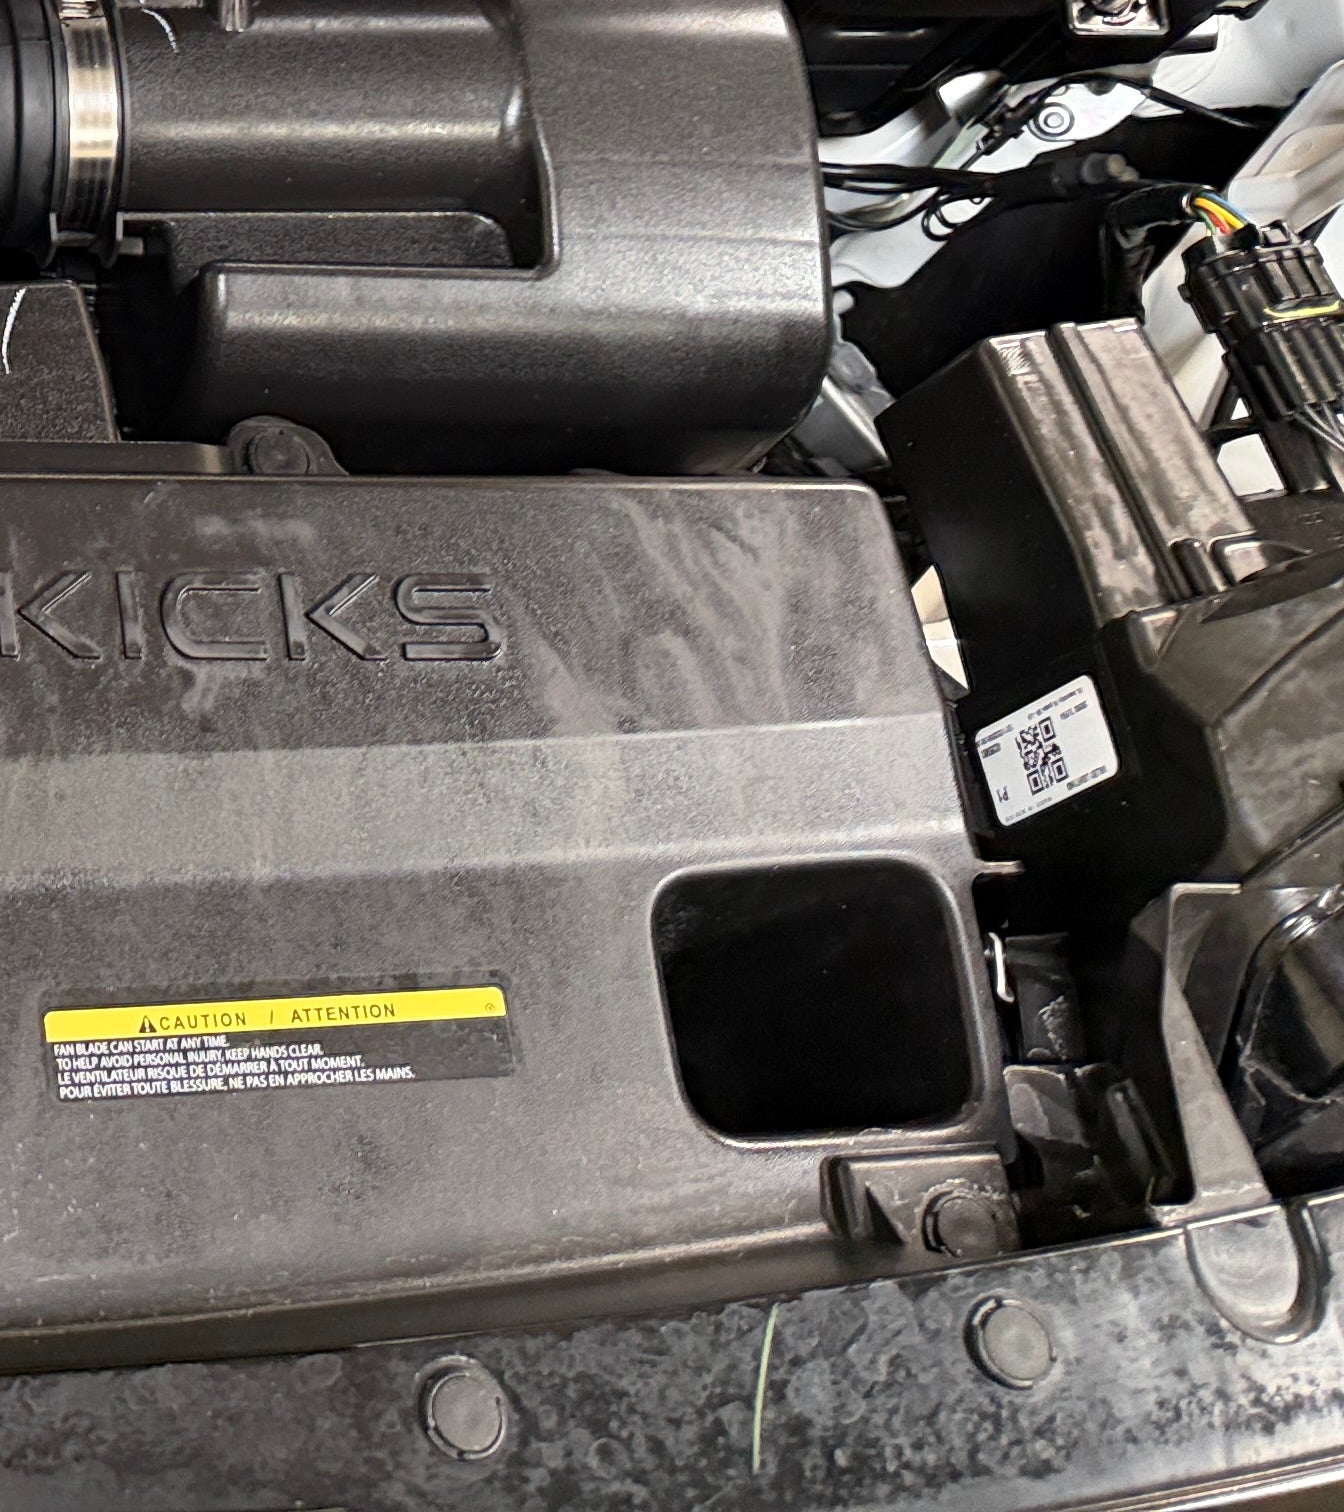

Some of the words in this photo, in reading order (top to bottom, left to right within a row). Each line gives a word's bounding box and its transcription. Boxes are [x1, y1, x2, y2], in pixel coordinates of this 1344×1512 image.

[159, 1011, 246, 1031] CAUTION
[291, 1003, 396, 1024] ATTENTION
[54, 1043, 75, 1057] FAN
[75, 1041, 109, 1057] BLADE
[110, 1040, 133, 1053] CAN
[135, 1038, 165, 1052] START
[167, 1037, 180, 1050] AT
[181, 1036, 203, 1049] ANY
[203, 1034, 230, 1048] TIME.
[56, 1059, 72, 1071] TO
[73, 1058, 98, 1071] HELP
[100, 1055, 133, 1068] AVOID
[134, 1053, 186, 1067] PERSONAL
[225, 1047, 250, 1061] KEEP
[251, 1045, 288, 1059] HANDS
[289, 1043, 324, 1057] CLEAR.
[57, 1073, 72, 1085] LE
[72, 1069, 146, 1084] VENTILATEUR
[147, 1066, 189, 1081] RISQUE
[189, 1065, 205, 1077] DE
[206, 1060, 267, 1077] DÉMARRER
[269, 1058, 278, 1073] À
[278, 1058, 309, 1072] TOUT
[311, 1054, 365, 1070] MOMENT.
[60, 1085, 92, 1100] POUR
[93, 1082, 131, 1098] ÉVITER
[132, 1081, 169, 1096] TOUTE
[170, 1078, 228, 1094] BLESSURE,
[229, 1077, 245, 1089] NE
[246, 1075, 267, 1089] PAS
[269, 1074, 284, 1088] EN
[285, 1071, 354, 1086] APPROCHER
[354, 1069, 374, 1082] LES
[375, 1065, 416, 1080] MAINS.
